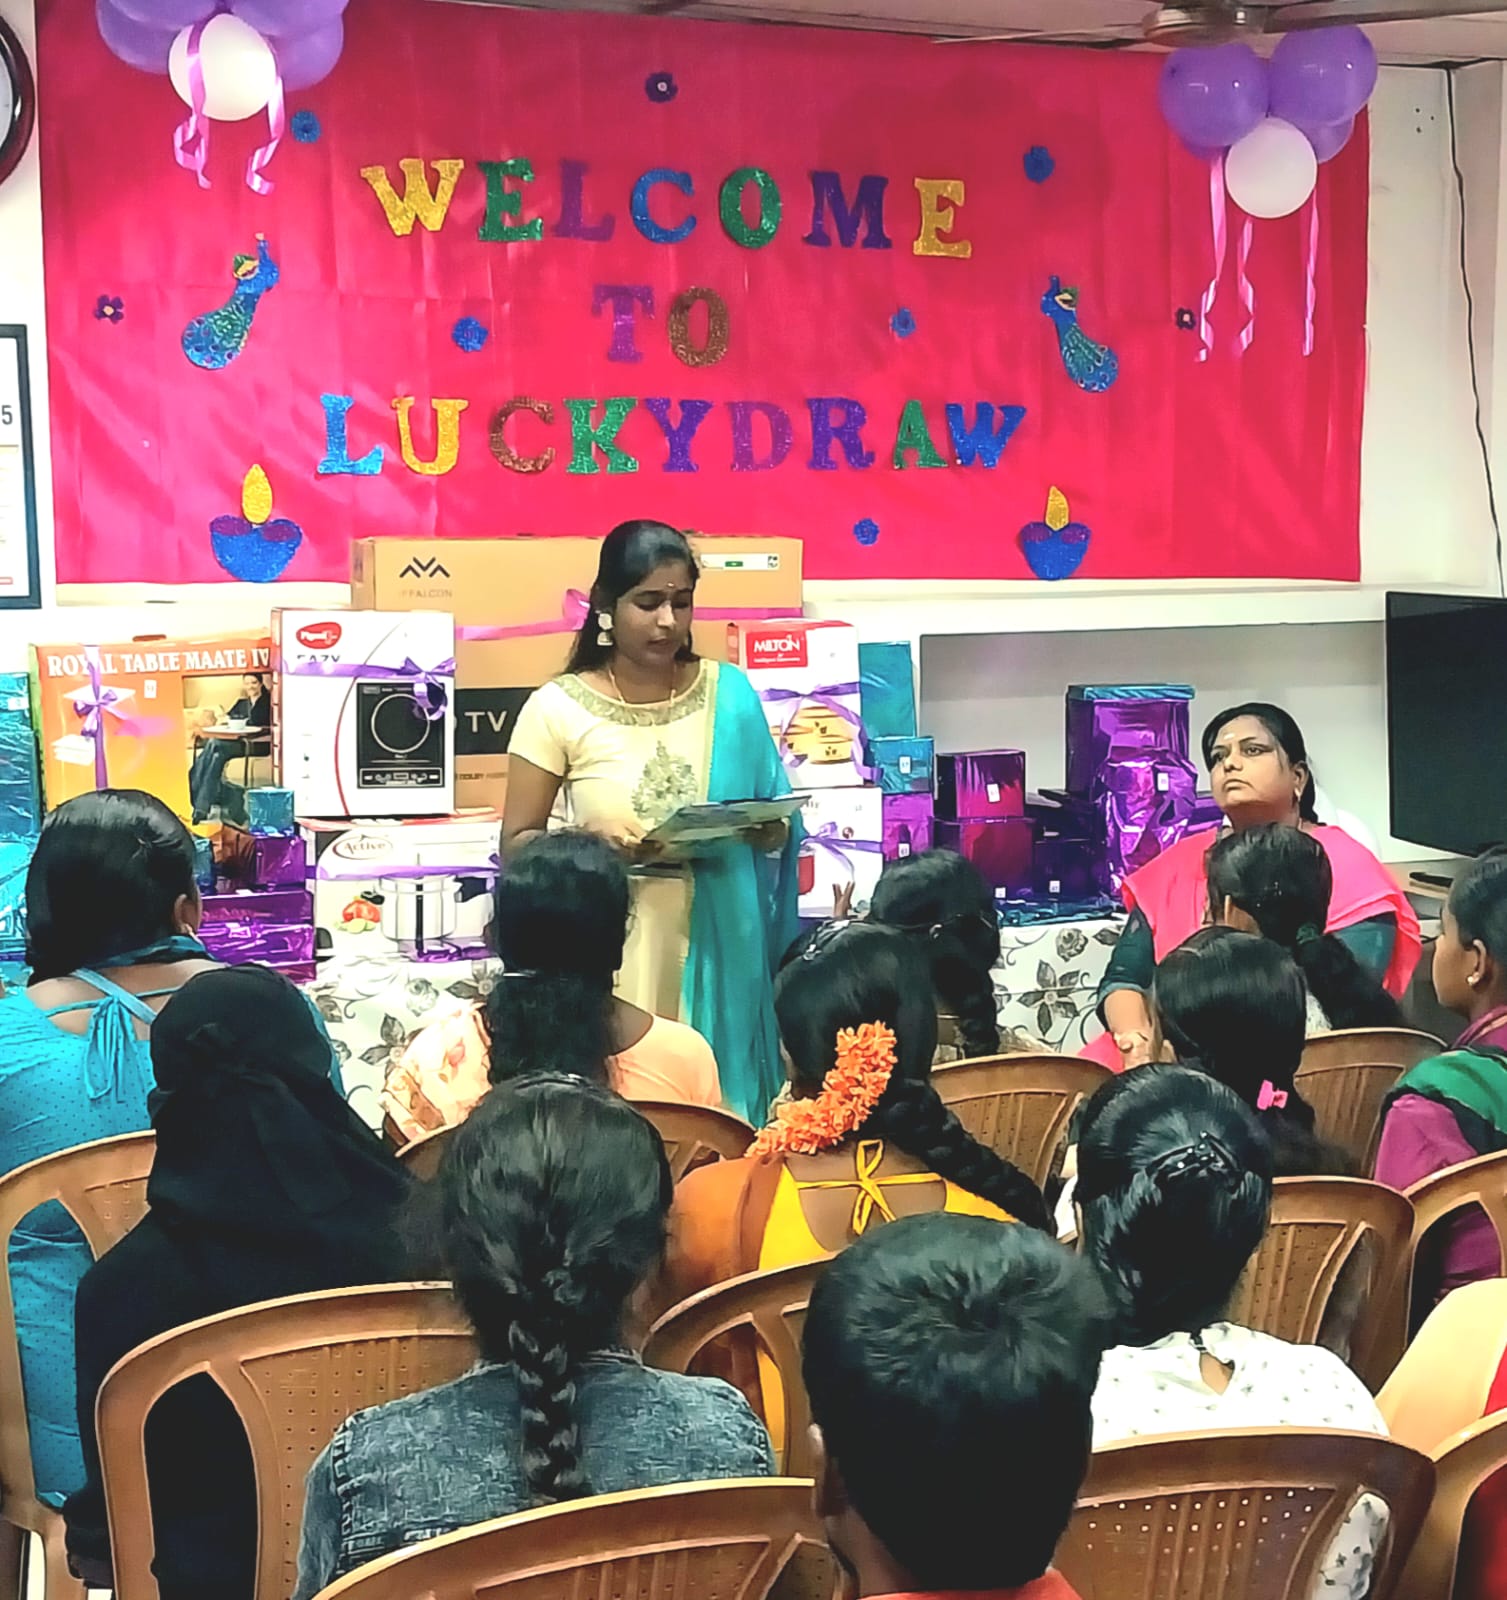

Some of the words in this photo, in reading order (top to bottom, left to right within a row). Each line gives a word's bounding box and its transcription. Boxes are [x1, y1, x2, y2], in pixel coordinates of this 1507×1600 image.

[361, 157, 972, 258] WELCOME
[592, 284, 730, 368] TO
[317, 393, 1027, 475] LUCKYDRAW
[753, 634, 801, 653] MILTON
[120, 651, 180, 673] TABLE
[182, 648, 247, 670] MAATE
[463, 710, 508, 733] TV
[344, 841, 387, 855] Active
